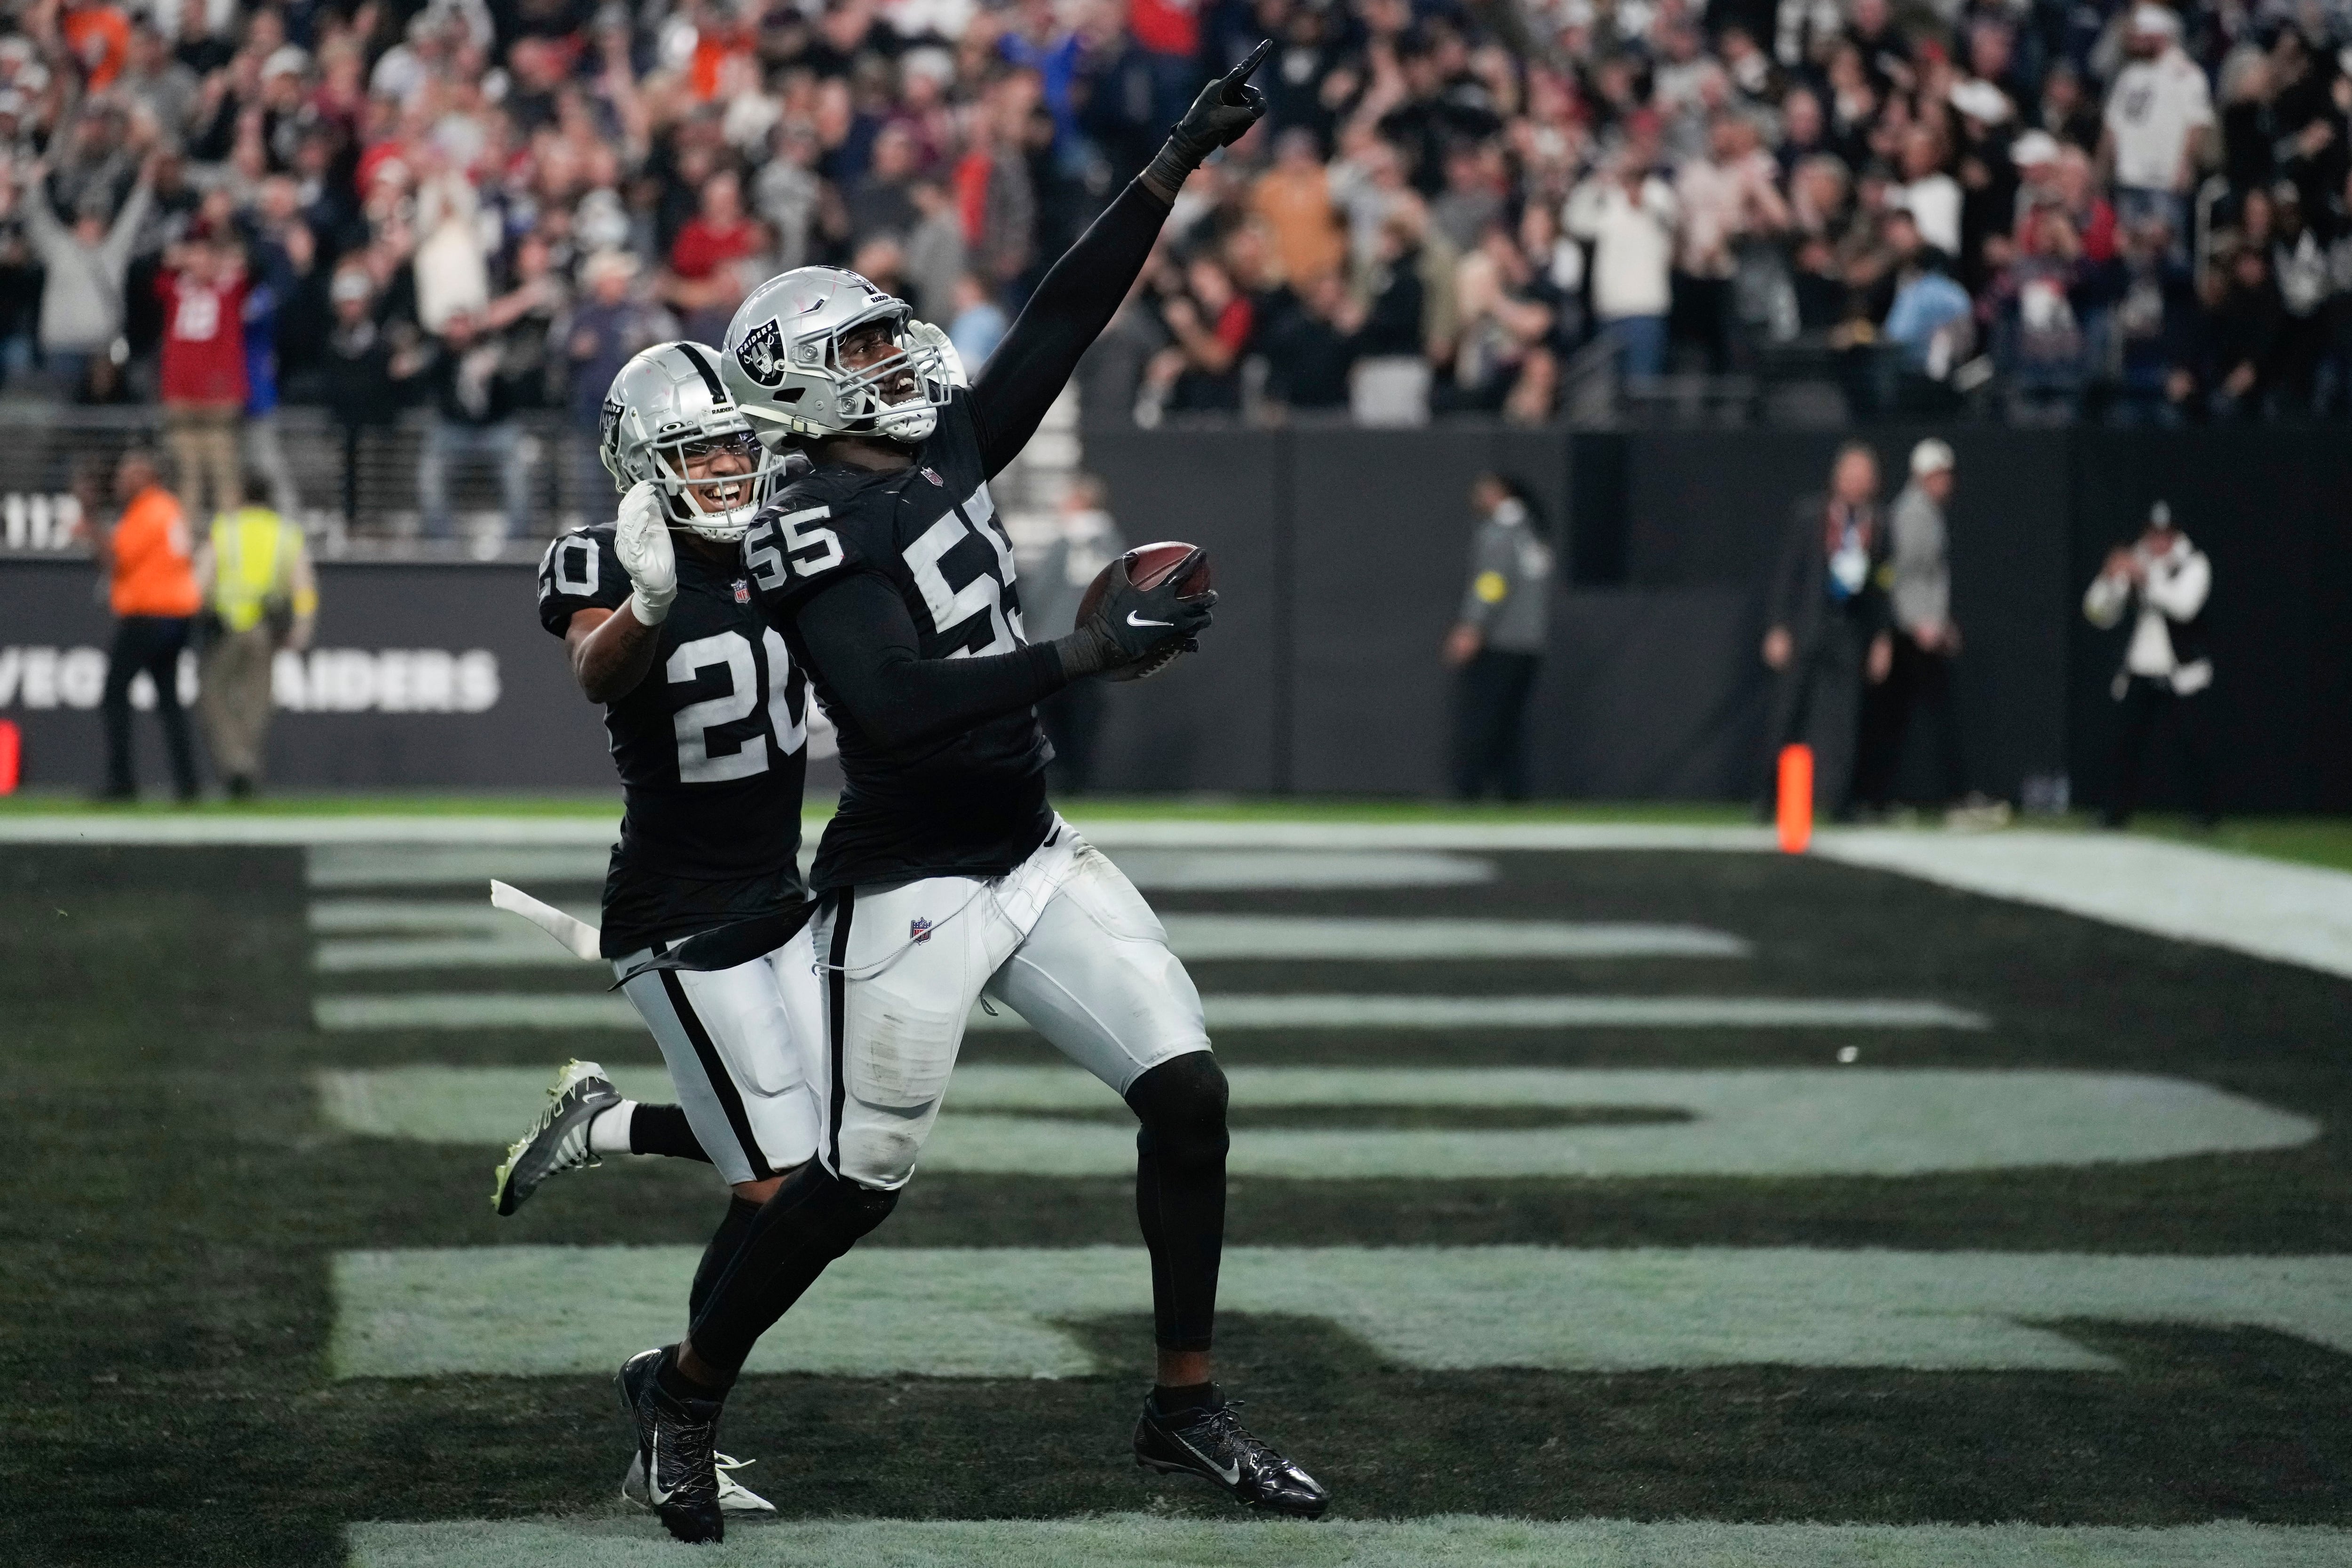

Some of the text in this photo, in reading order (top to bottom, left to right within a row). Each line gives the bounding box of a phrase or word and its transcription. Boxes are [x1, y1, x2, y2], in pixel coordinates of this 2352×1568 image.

[739, 323, 773, 354] RAIDERS
[537, 535, 600, 605] 20
[744, 505, 844, 591] 55
[270, 646, 501, 713] AIDERS
[666, 625, 808, 783] 20
